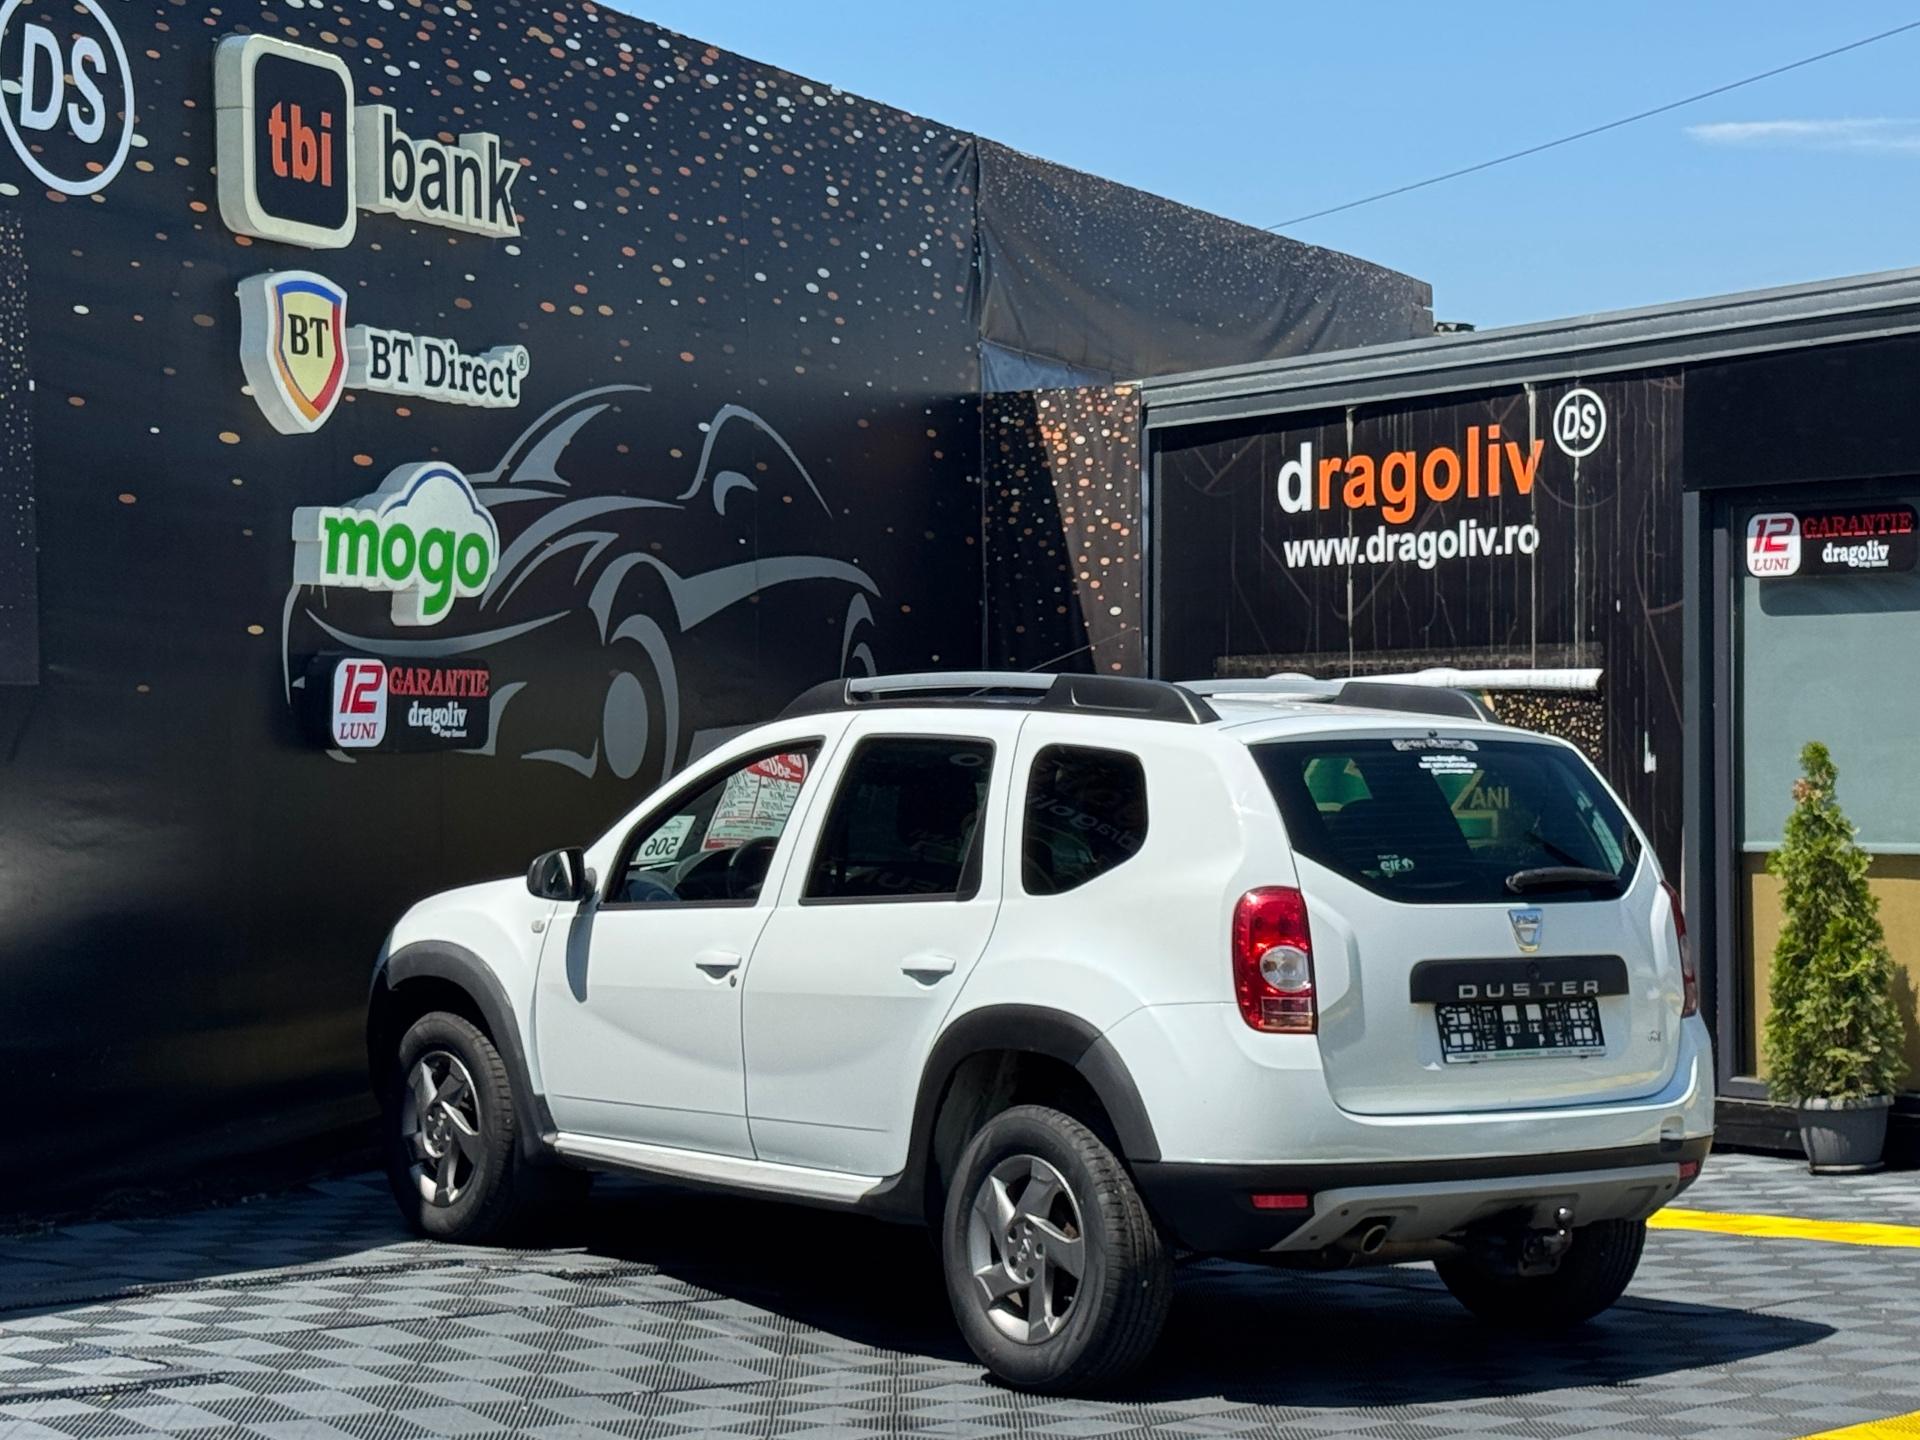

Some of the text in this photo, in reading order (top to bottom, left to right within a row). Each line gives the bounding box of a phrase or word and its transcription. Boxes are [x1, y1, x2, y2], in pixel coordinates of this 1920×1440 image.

[21, 22, 107, 144] DS
[268, 100, 519, 231] tbi bank
[287, 313, 329, 360] BT
[369, 333, 414, 384] BT
[1562, 401, 1597, 441] DS
[1276, 423, 1545, 525] dragoliv
[1282, 518, 1541, 570] www.dragoliv.ro
[1752, 517, 1795, 554] 12
[1801, 511, 1913, 540] GARANTIE
[323, 516, 490, 616] mogo
[1753, 557, 1790, 572] LUNI
[1821, 539, 1890, 567] dragoliv
[339, 663, 384, 715] 12
[388, 666, 490, 698] GARANTIE
[338, 722, 378, 740] LUNI
[407, 700, 468, 734] dragoliv
[1458, 980, 1600, 999] DUSTER
